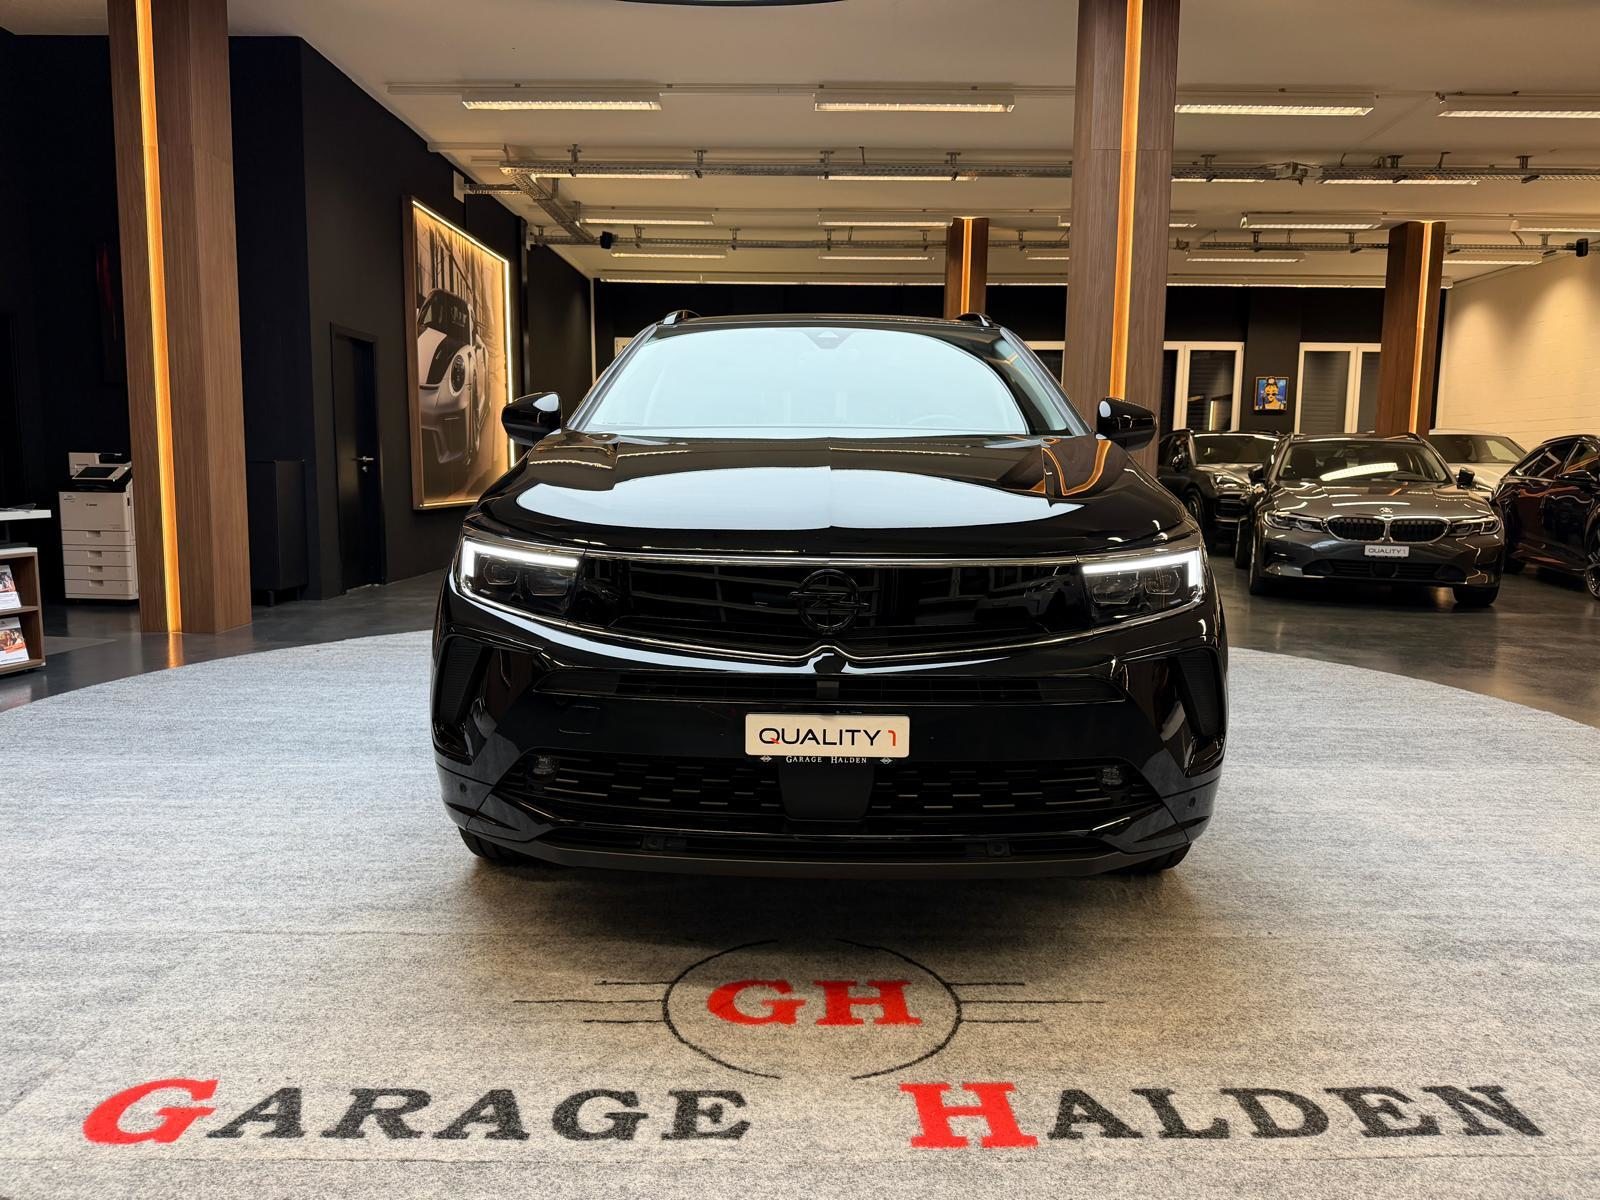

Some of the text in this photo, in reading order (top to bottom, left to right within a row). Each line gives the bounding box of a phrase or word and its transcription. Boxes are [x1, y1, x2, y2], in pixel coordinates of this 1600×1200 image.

[786, 756, 867, 765] GARAGE HALDEN
[706, 980, 923, 1026] GH
[83, 1078, 1545, 1149] GARAGE HALDEN
